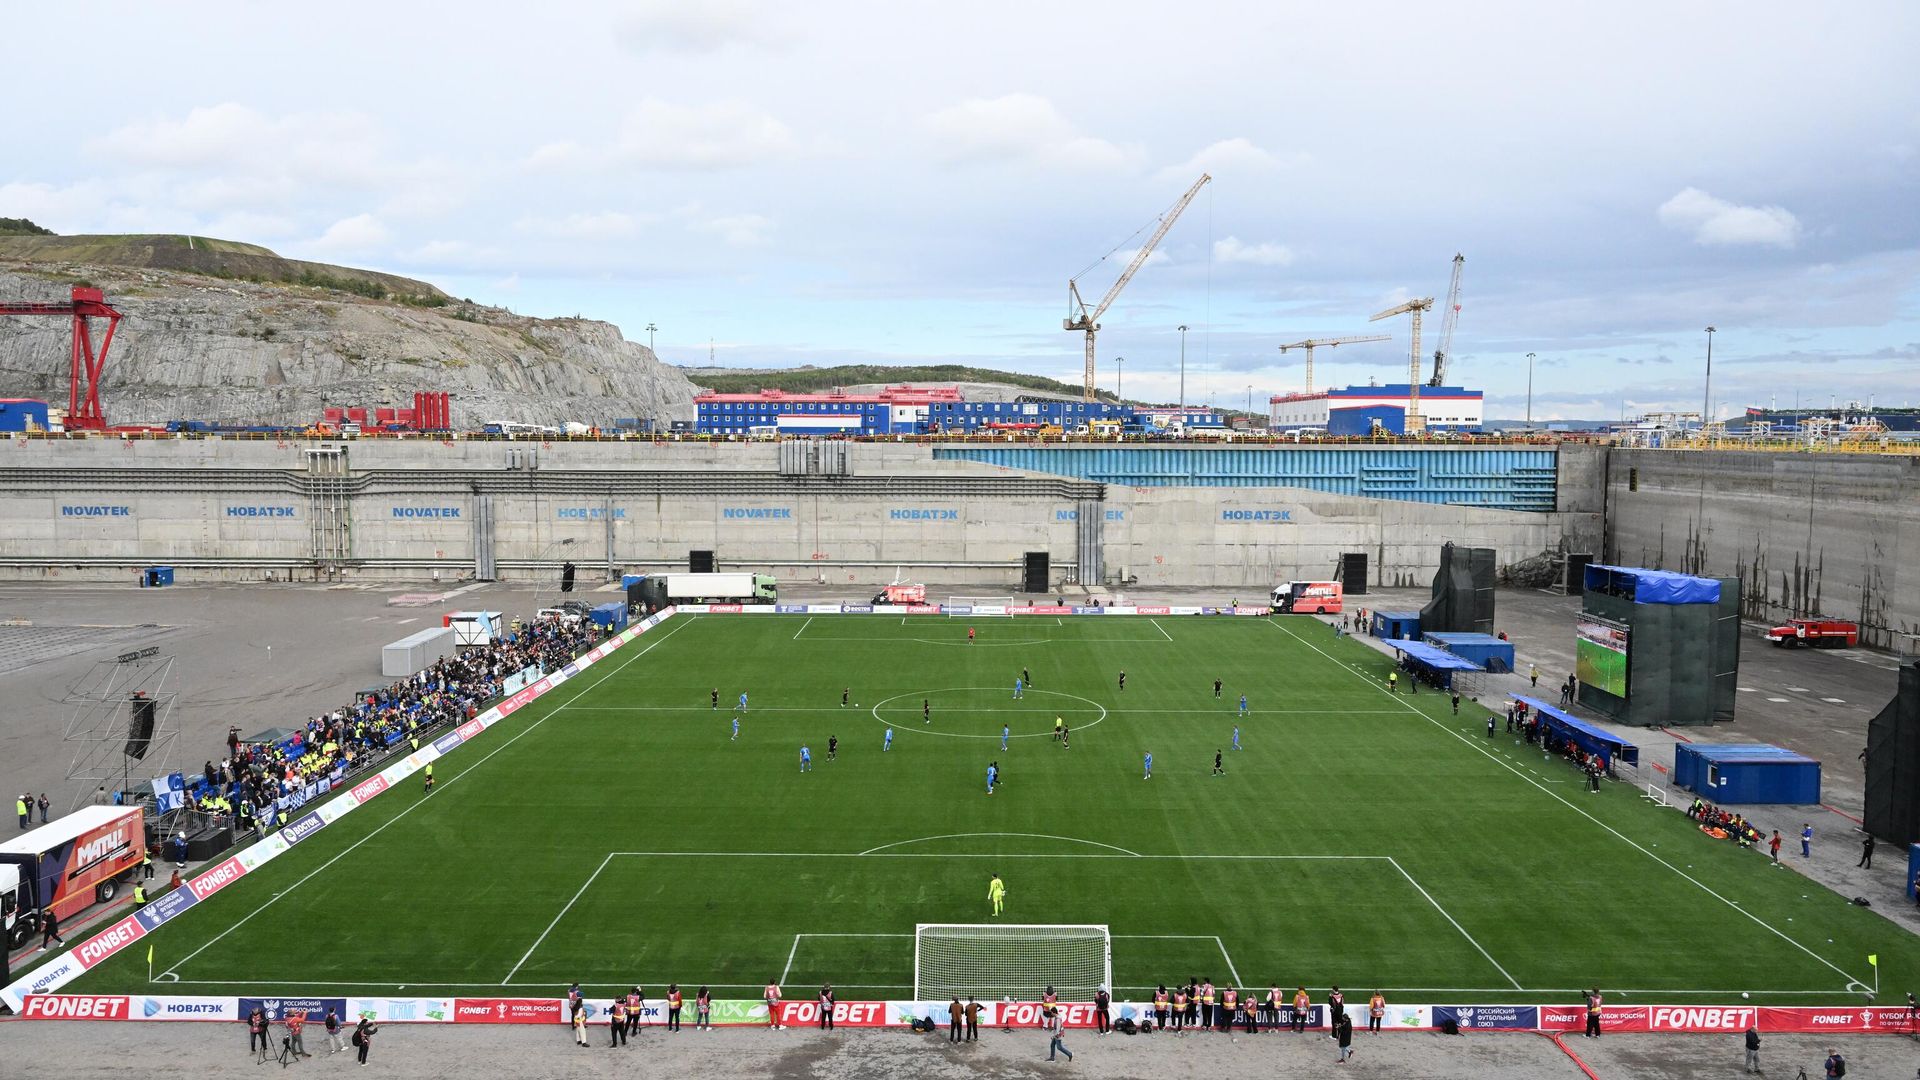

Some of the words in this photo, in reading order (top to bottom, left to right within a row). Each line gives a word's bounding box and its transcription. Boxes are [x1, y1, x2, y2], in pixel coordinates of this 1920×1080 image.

[62, 506, 129, 516] NOVATEK
[227, 507, 295, 517] НОВАТЭК
[392, 507, 460, 517] NOVATEK
[723, 508, 791, 518] NOVATEK
[890, 509, 958, 519] НОВАТЭК
[1056, 510, 1124, 520] NOEK
[1222, 510, 1291, 520] НОВАТЭК
[355, 777, 384, 801] FONBET
[293, 816, 320, 835] ВОСТОК
[195, 862, 238, 895] FONBET
[80, 922, 136, 963] FONBET
[32, 965, 70, 991] НОВАТЭК
[26, 998, 124, 1017] FONBET
[167, 1004, 223, 1013] НОВАТЭК
[458, 1006, 492, 1014] FONBET
[1654, 1008, 1753, 1028] FONBET
[1812, 1015, 1853, 1024] FONBET
